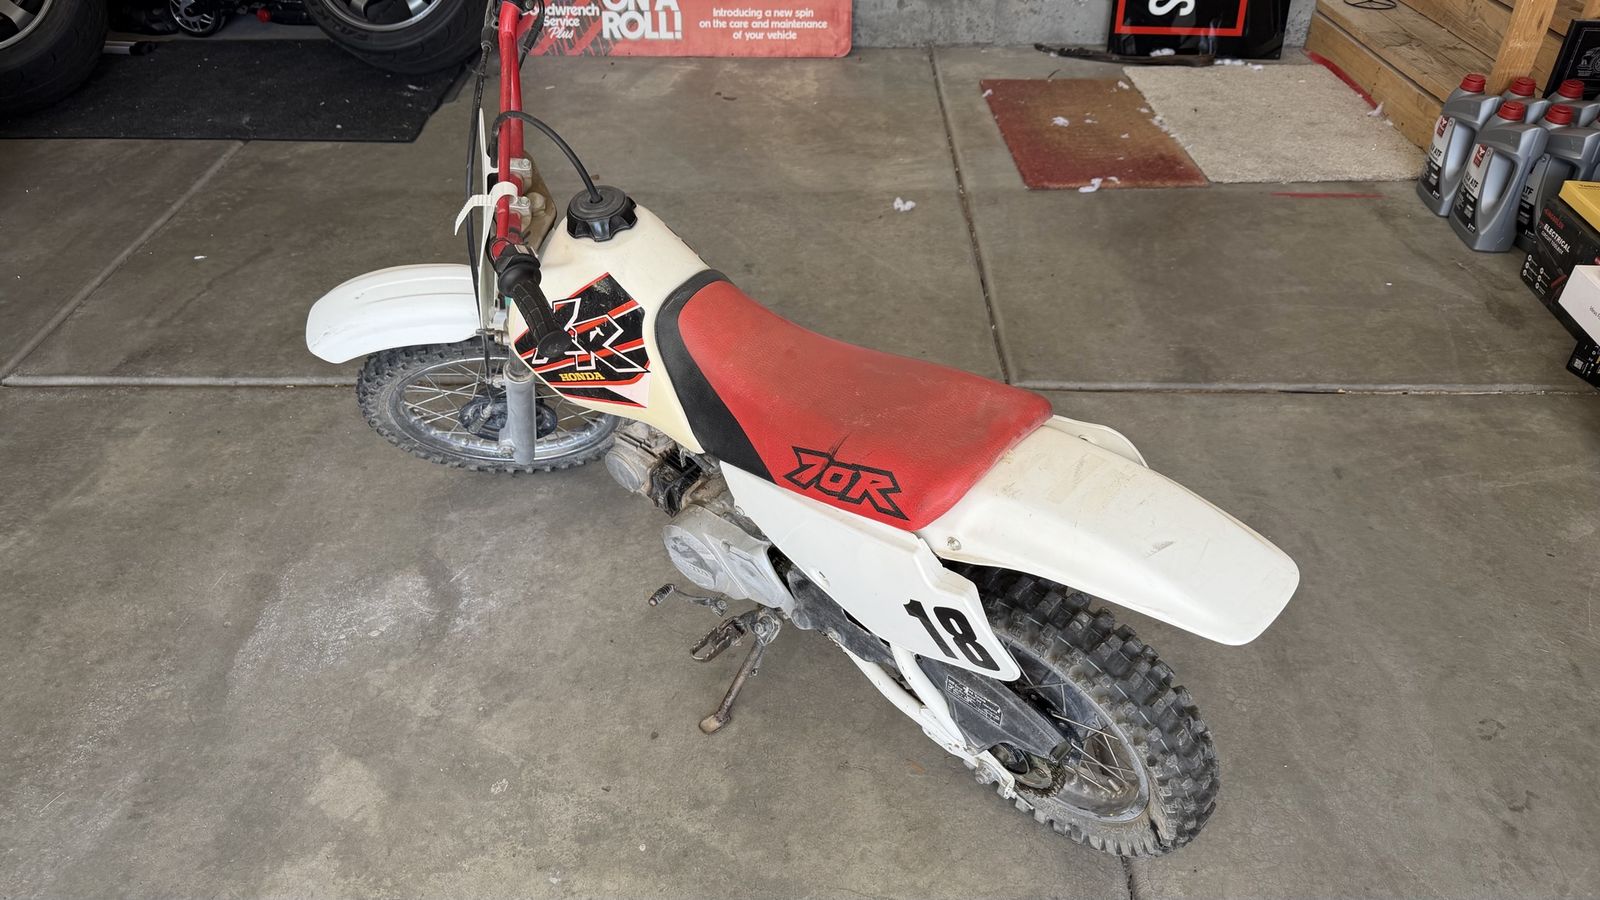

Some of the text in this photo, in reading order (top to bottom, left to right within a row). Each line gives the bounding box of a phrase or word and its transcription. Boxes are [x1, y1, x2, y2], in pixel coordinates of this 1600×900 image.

[712, 8, 763, 19] Introducing
[795, 8, 814, 19] spin
[544, 17, 580, 27] Service
[602, 11, 682, 39] ROLL!
[712, 19, 727, 28] the
[751, 19, 769, 28] and
[770, 19, 828, 28] maintenance
[549, 27, 574, 39] Plus
[732, 31, 797, 41] of your vehicle
[1543, 223, 1571, 253] ELECTRICAL
[558, 371, 606, 382] HONDA
[783, 446, 911, 521] 70R
[903, 599, 1001, 671] 18
